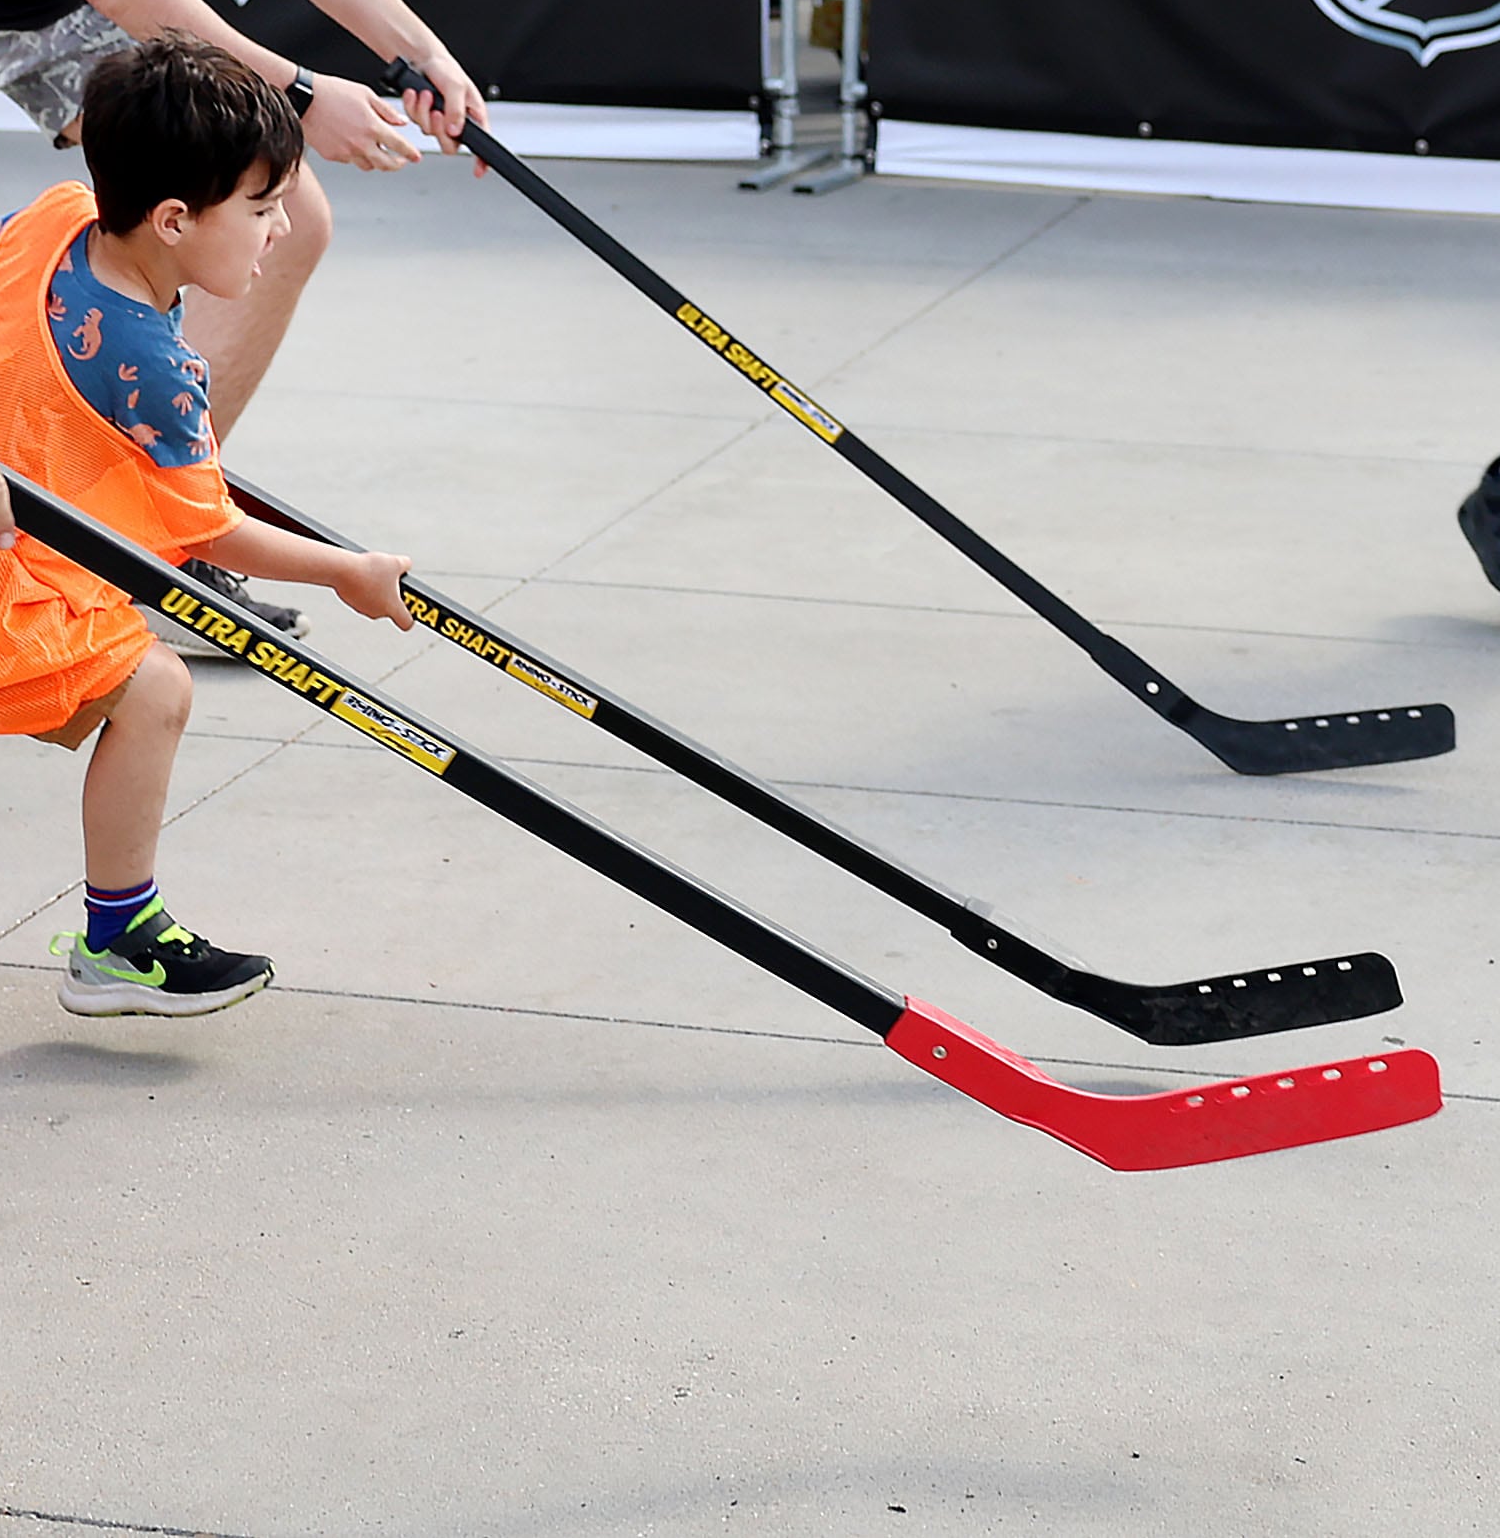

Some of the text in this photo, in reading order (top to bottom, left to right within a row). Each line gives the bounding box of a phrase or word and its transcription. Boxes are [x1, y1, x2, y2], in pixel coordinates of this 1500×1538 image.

[676, 302, 781, 389] ULTRA SHAFT
[160, 587, 252, 655] ULTRA
[247, 641, 345, 703] SHAFT
[402, 590, 440, 628] TRA
[440, 617, 510, 665] SHAFT
